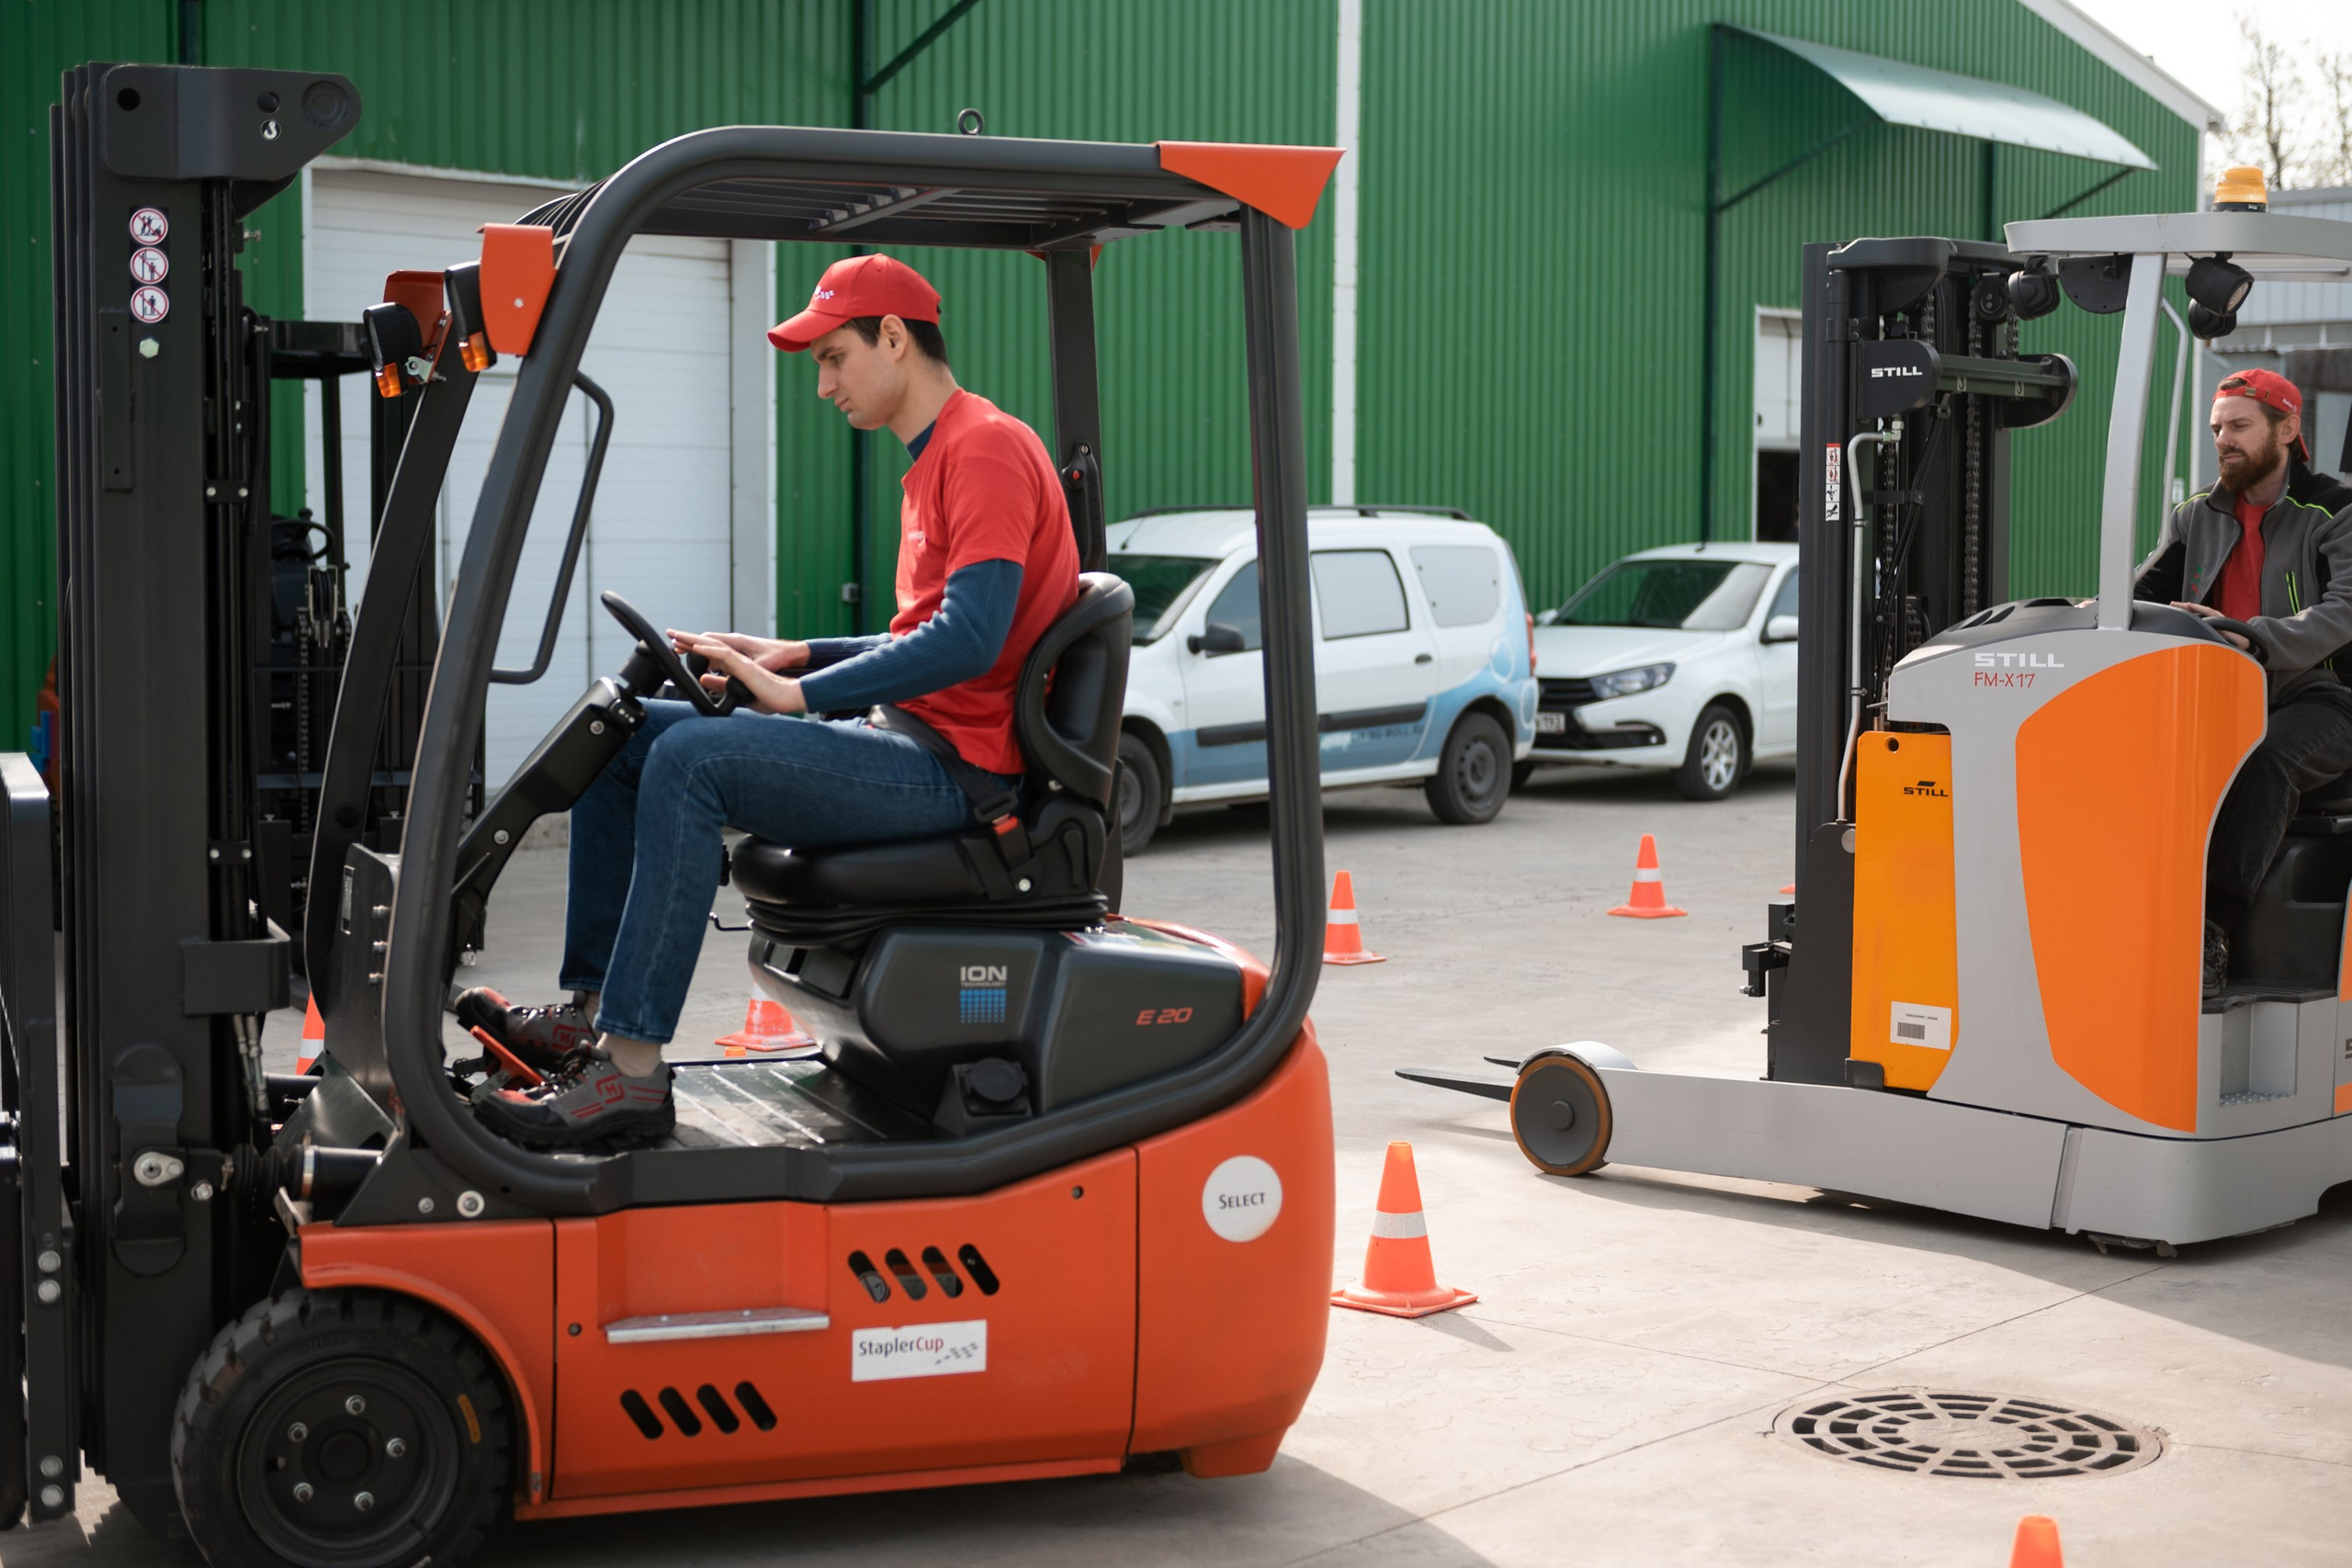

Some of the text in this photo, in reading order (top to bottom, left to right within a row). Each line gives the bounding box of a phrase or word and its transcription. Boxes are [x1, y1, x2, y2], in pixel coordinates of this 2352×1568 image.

[1871, 366, 1923, 378] STILL
[1974, 652, 2064, 668] STILL
[1974, 671, 2035, 688] FM-X17
[1903, 786, 1949, 797] STILL
[960, 965, 1007, 981] ION
[1136, 1007, 1193, 1025] E 20
[1218, 1191, 1265, 1210] SELECT
[859, 1336, 944, 1358] StaplerCup
